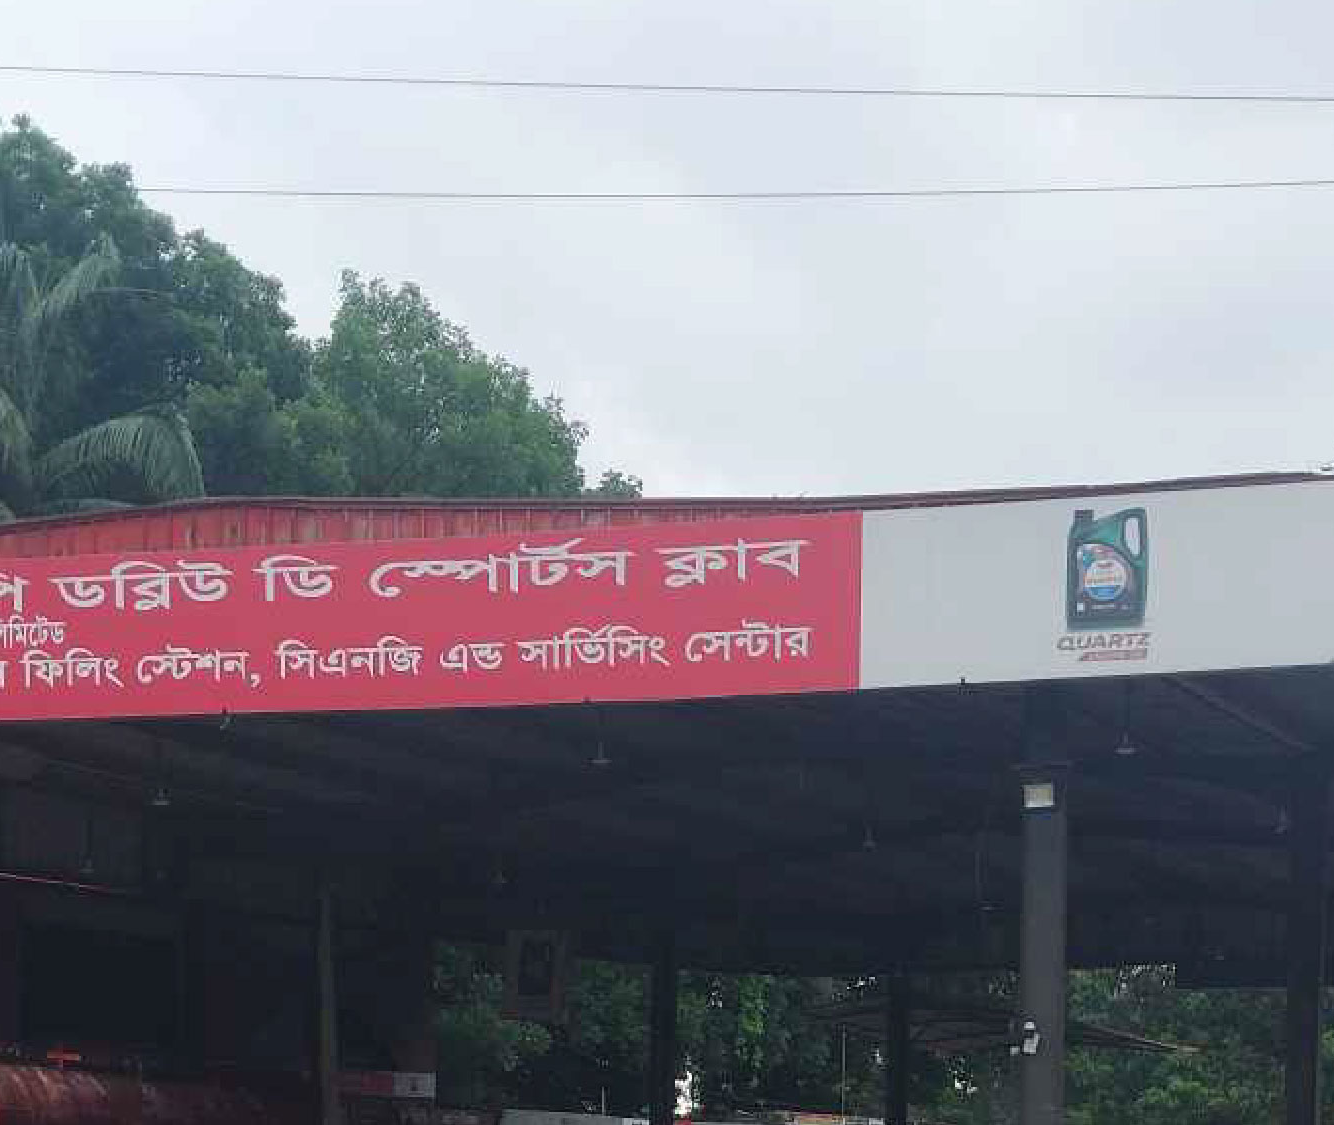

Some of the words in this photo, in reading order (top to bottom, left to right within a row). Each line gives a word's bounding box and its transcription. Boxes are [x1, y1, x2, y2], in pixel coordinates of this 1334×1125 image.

[252, 554, 340, 601] ডি
[368, 537, 636, 598] স্পোর্টস
[655, 537, 811, 588] ক্লাব
[19, 648, 124, 688] ফিলিং
[274, 635, 423, 679] সিএনজি
[517, 623, 671, 671] সার্ভিসিং
[685, 617, 813, 663] সেন্টার
